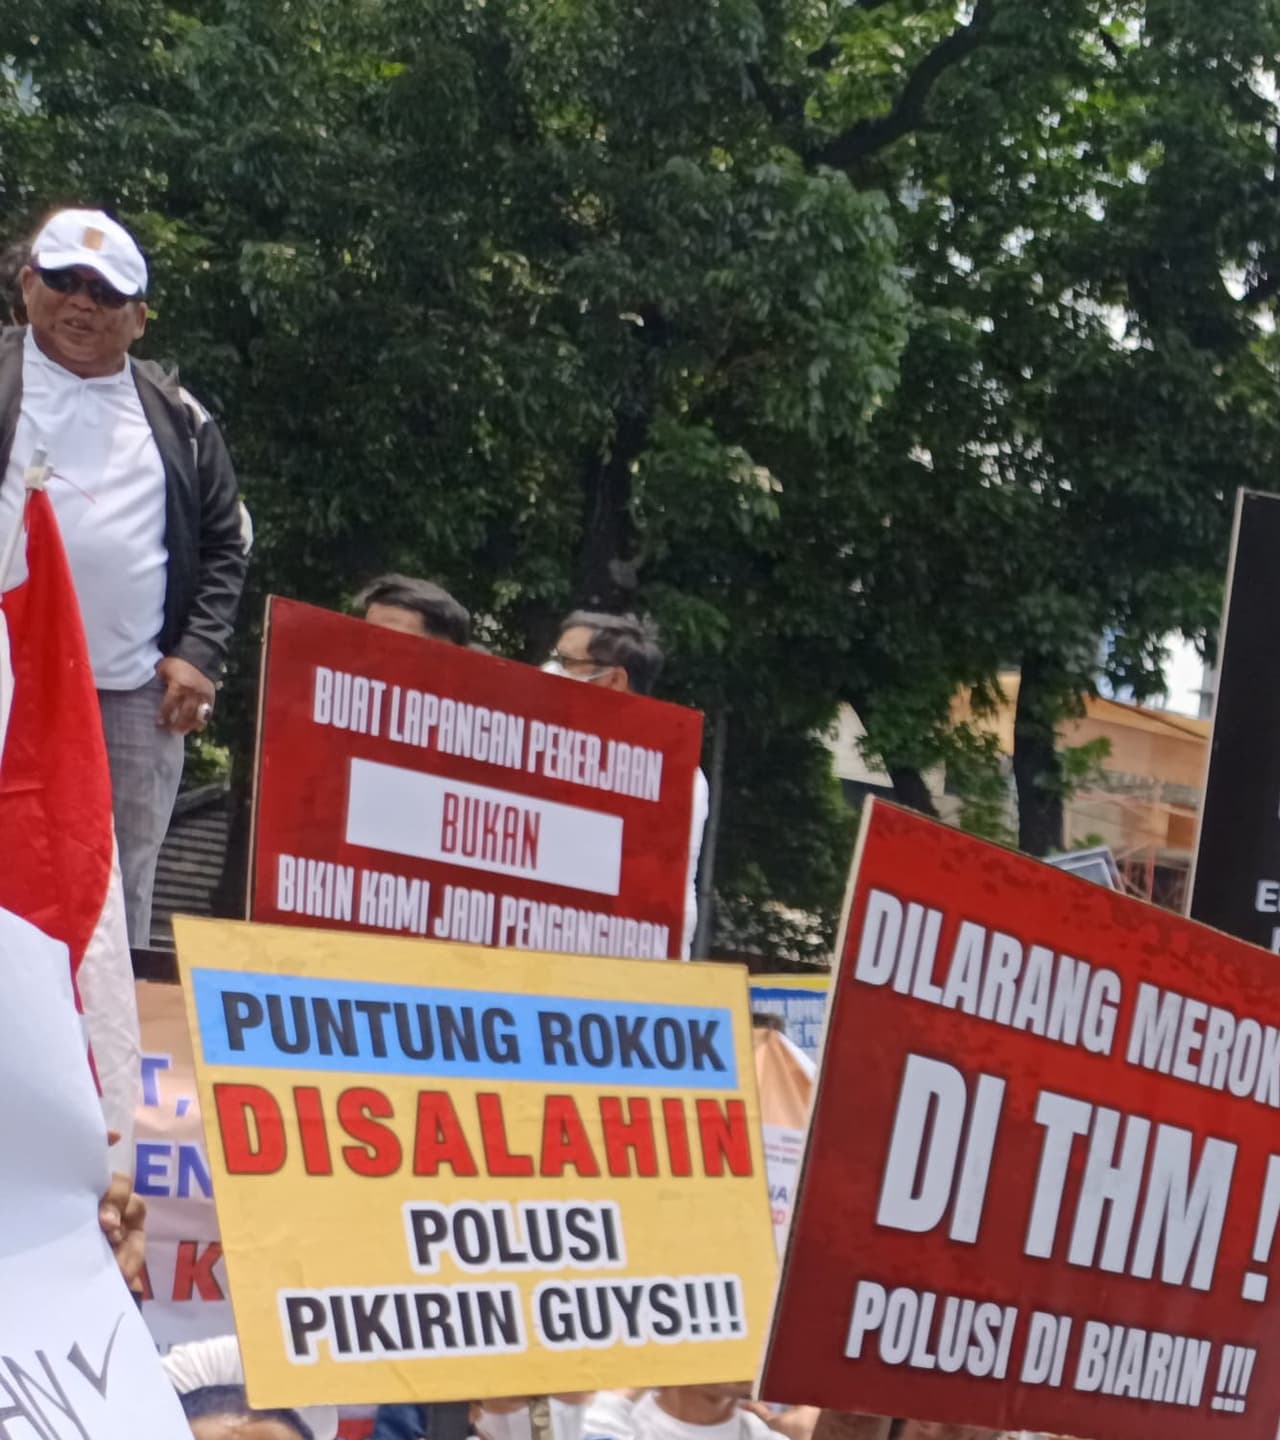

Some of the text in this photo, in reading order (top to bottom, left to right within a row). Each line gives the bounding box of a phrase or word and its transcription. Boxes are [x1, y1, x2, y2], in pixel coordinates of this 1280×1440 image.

[313, 667, 663, 801] BUAT LAPANGAN PEKERJAAN
[441, 792, 540, 871] BUKAN
[278, 855, 669, 960] BIKIN KAMI JADI PENGANGURAN
[855, 888, 1122, 1056] DILARANG
[221, 991, 727, 1072] PUNTUNG ROKOK
[214, 1082, 754, 1178] DISALAHIN
[876, 1053, 1006, 1245] DI
[1024, 1089, 1238, 1292] THM
[410, 1206, 620, 1265] POLUSI
[286, 1280, 743, 1356] PIKIRIN GUYS!!!
[845, 1279, 1018, 1380] POLUSI
[1022, 1311, 1072, 1387] DI
[1074, 1321, 1211, 1408] BIARIN
